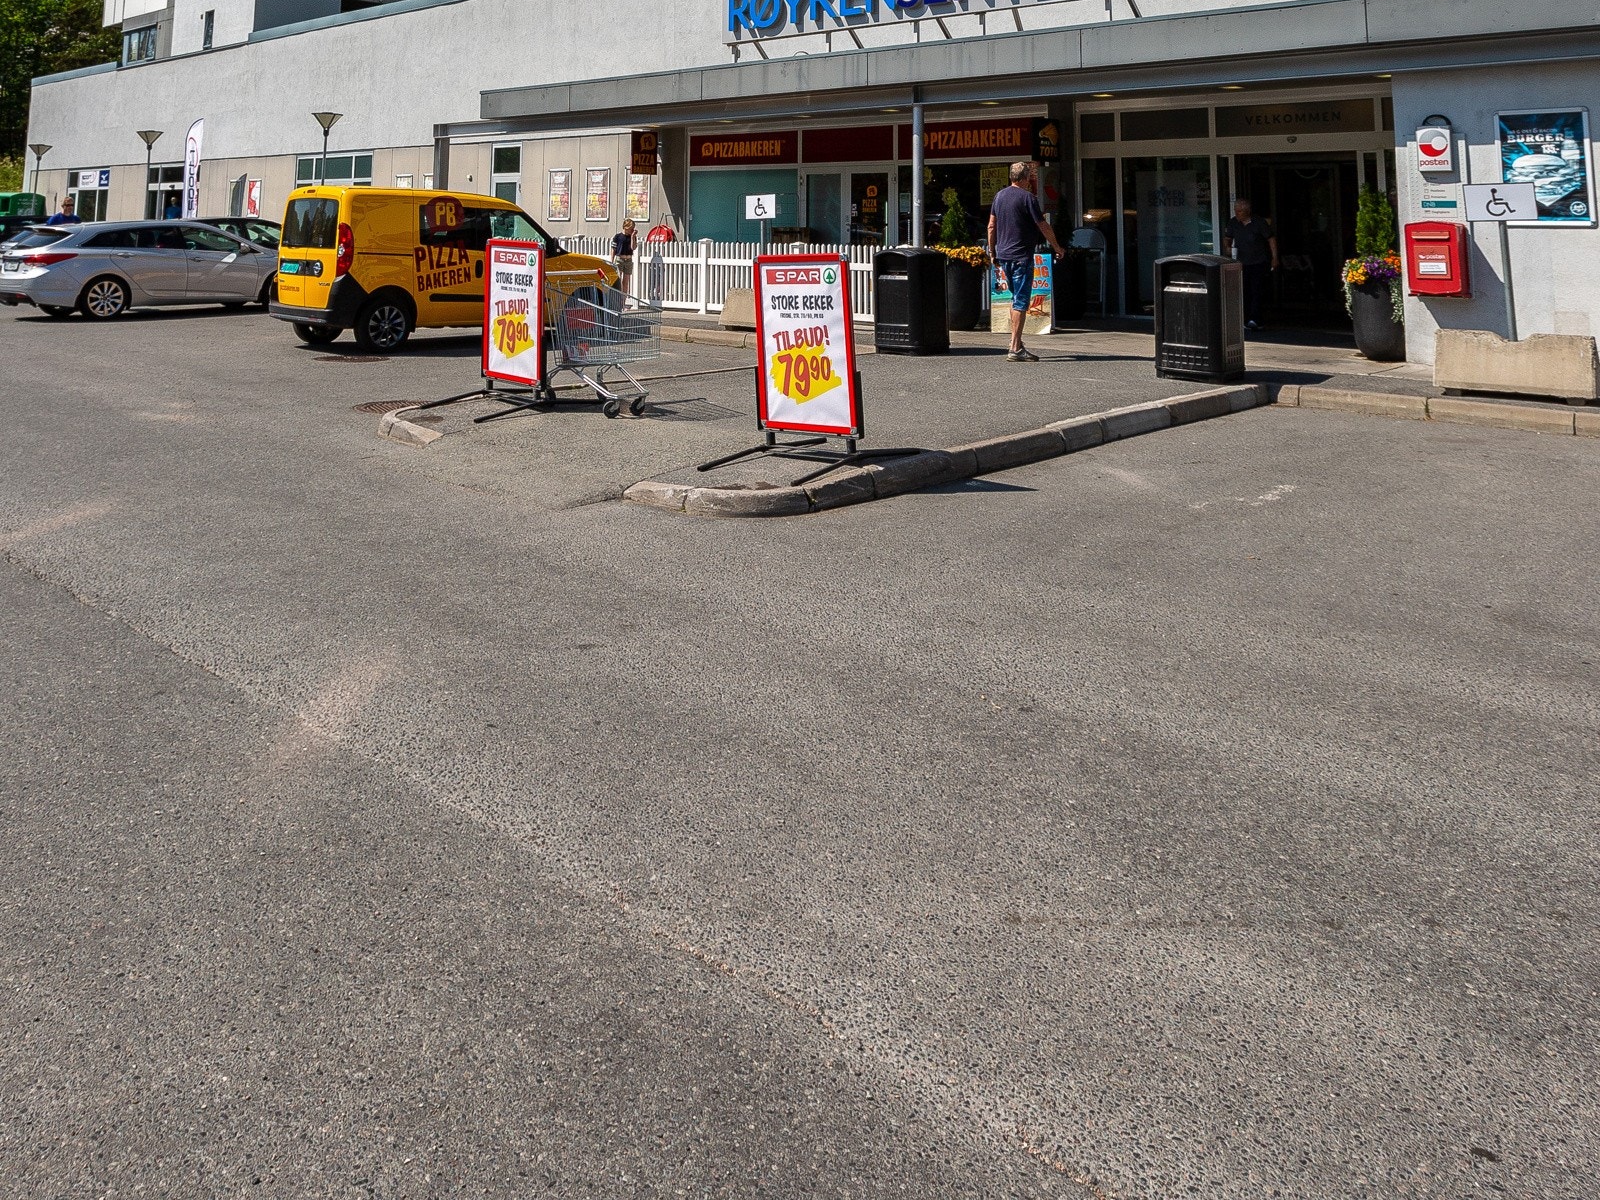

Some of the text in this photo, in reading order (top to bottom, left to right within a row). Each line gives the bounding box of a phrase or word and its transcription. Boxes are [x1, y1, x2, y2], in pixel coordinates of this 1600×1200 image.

[1244, 111, 1341, 125] VELKOMMEN
[1507, 133, 1566, 143] BURGER
[633, 153, 655, 165] PIZZA
[1419, 159, 1449, 168] posten
[435, 202, 456, 227] PB
[413, 240, 470, 273] PIZZA
[499, 252, 526, 264] SPAR
[416, 266, 472, 292] BAKEREN
[495, 271, 534, 288] STORE REKER
[775, 271, 820, 283] SPAR
[495, 298, 529, 317] TILBUD!
[771, 294, 834, 311] STORE REKER
[772, 325, 830, 352] TILBUD!
